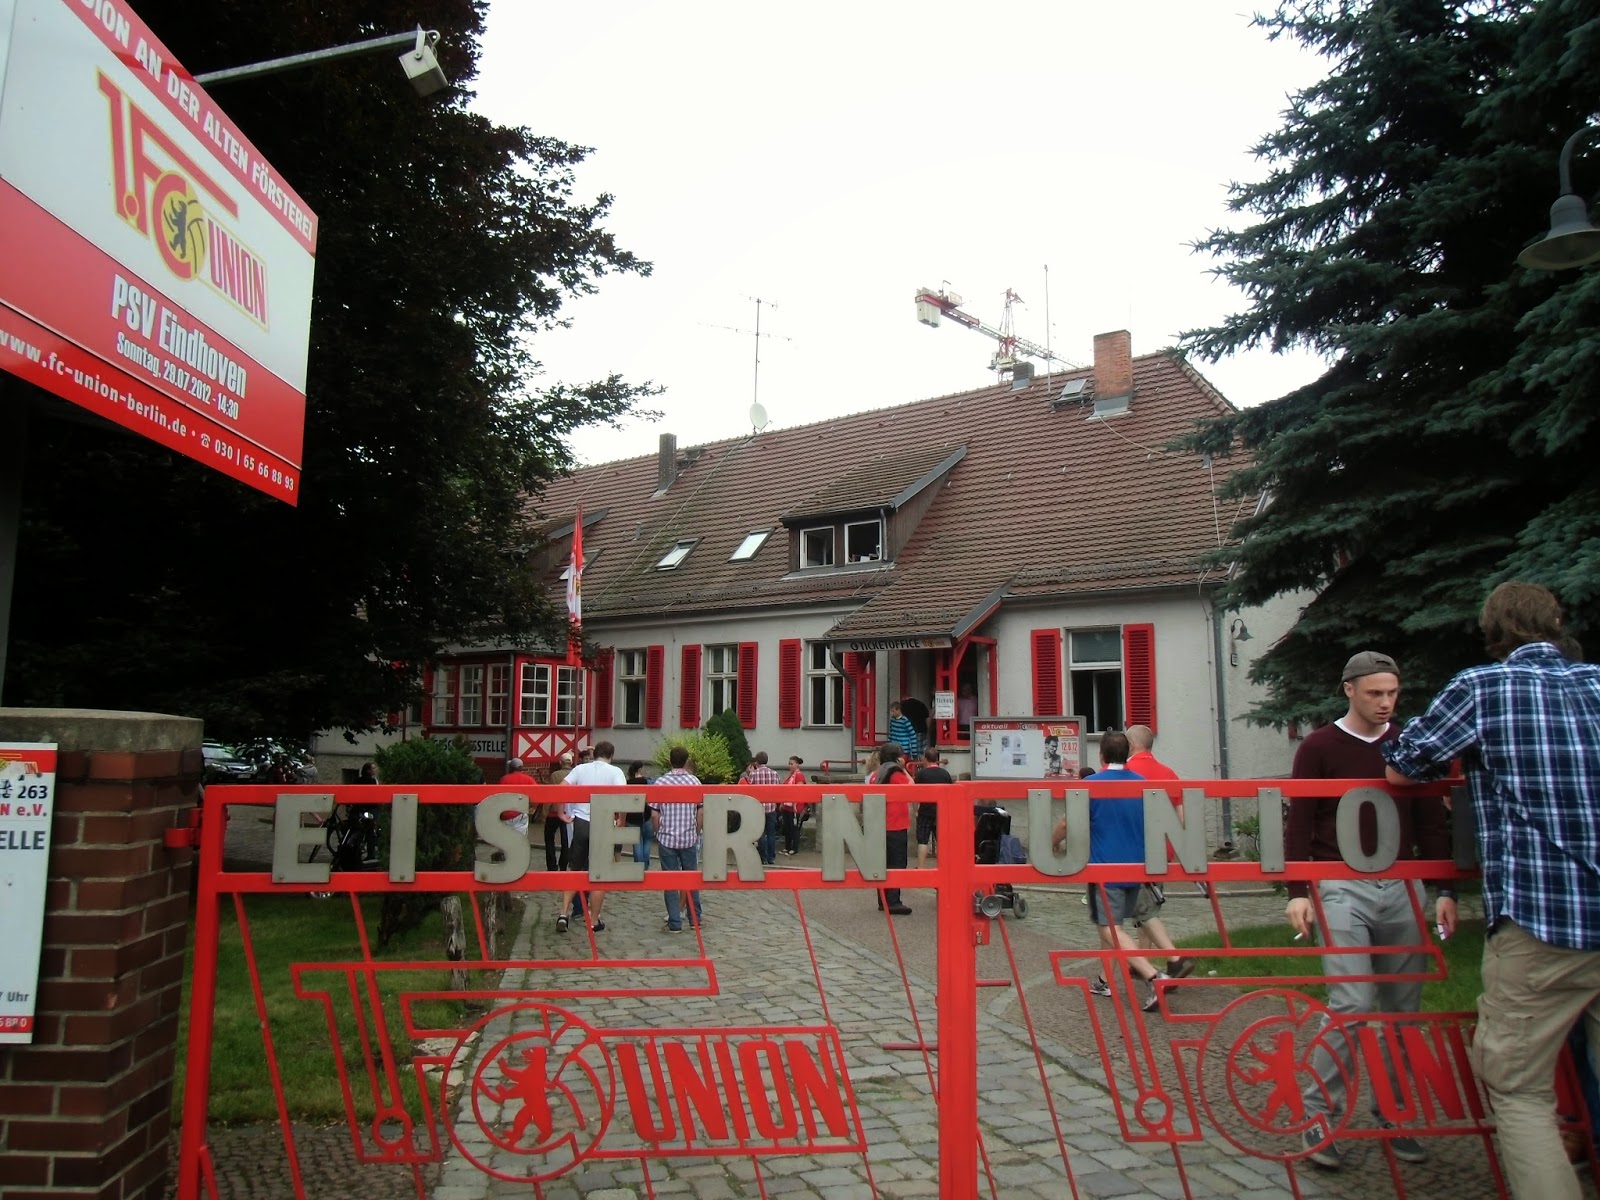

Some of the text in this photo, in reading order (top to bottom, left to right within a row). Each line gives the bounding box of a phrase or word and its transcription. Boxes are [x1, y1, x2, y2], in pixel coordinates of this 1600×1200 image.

[135, 37, 162, 83] AN
[168, 69, 200, 123] DER
[203, 111, 248, 174] ALTEN
[252, 161, 313, 242] FÖRSTEREI
[208, 217, 267, 325] UNION
[111, 273, 247, 399] PSV Eindhoven
[116, 331, 161, 379] Sonntag,
[217, 392, 239, 421] 14:30
[214, 439, 233, 460] 030
[243, 454, 255, 471] 65
[258, 462, 269, 478] 66
[271, 468, 282, 485] 88
[284, 475, 294, 491] 93
[860, 639, 920, 651] TICKETOFFICE
[16, 803, 47, 817] e.V.
[17, 785, 48, 799] 263
[271, 792, 886, 885] EISERN
[7, 991, 29, 1002] Uhr
[615, 1040, 852, 1142] UNION
